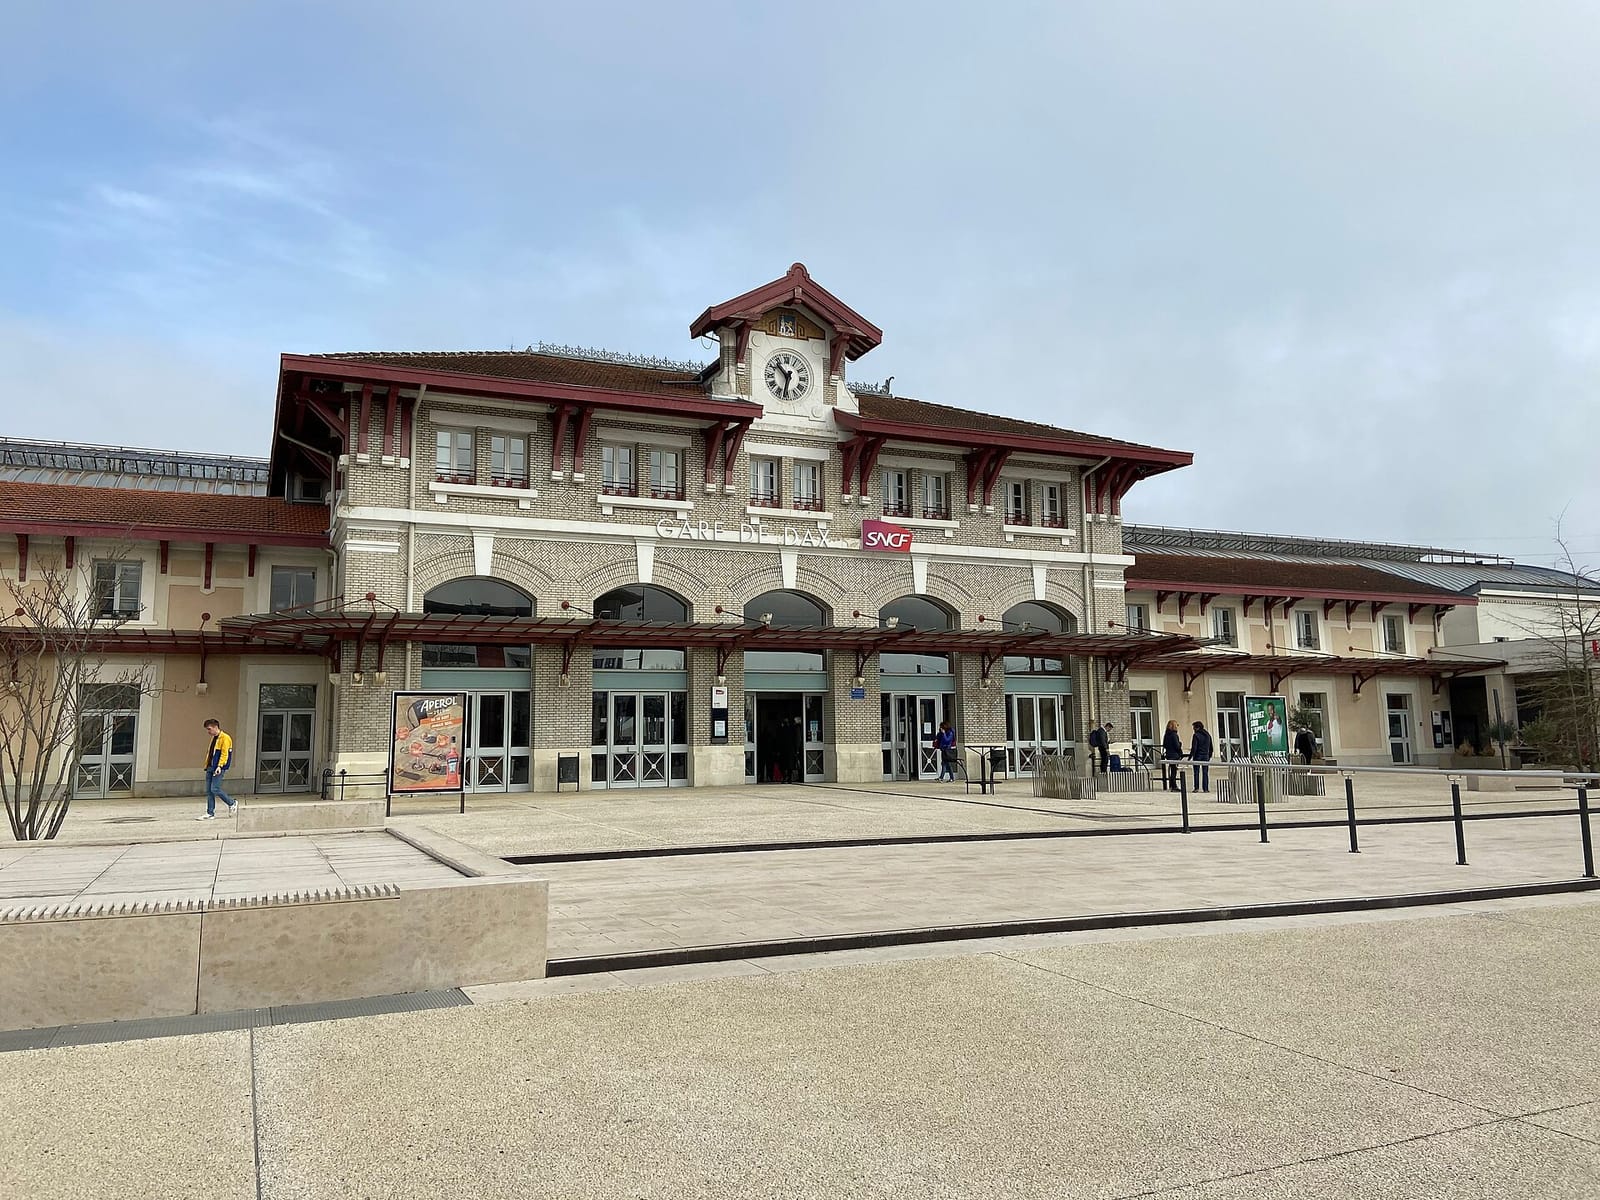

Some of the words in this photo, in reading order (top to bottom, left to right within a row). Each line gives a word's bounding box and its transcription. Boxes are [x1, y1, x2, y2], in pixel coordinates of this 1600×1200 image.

[656, 518, 725, 541] GARE
[739, 523, 769, 544] DE
[783, 526, 830, 548] DAX
[865, 531, 911, 548] SNCF
[420, 696, 458, 712] APEROL
